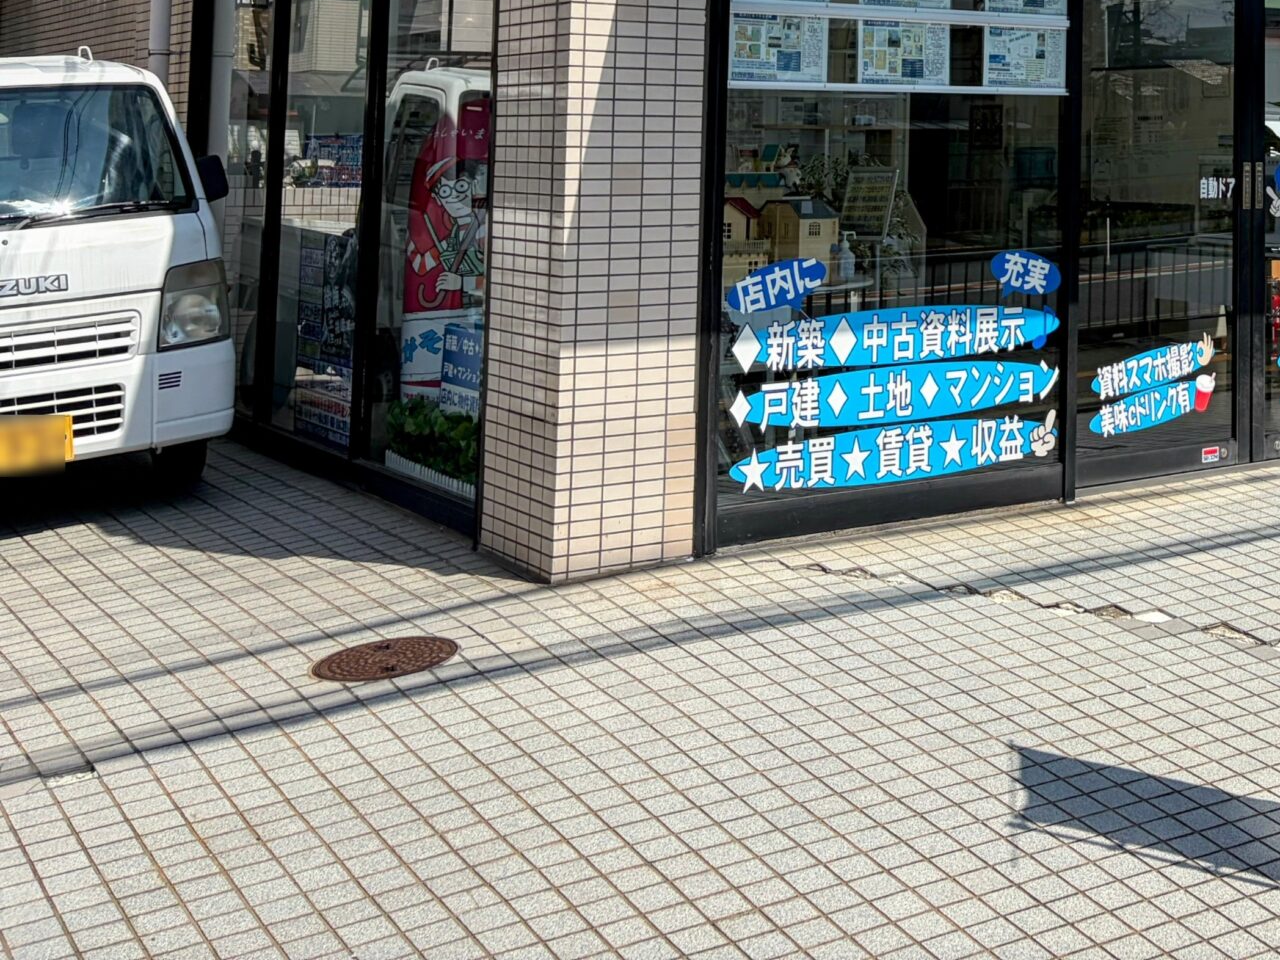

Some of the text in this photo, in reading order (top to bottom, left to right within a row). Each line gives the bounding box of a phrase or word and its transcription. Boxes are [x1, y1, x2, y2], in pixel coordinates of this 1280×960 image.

[1199, 176, 1236, 200] 自動ドア
[736, 257, 822, 315] 店内に
[1001, 252, 1051, 295] 充実
[766, 306, 1026, 371] 新築 中古資料展示
[760, 359, 1060, 433] 戸建 土地 マンション
[1097, 342, 1195, 401] 資料スマホ撮影
[775, 414, 1025, 491] 売買 賃貸 収益
